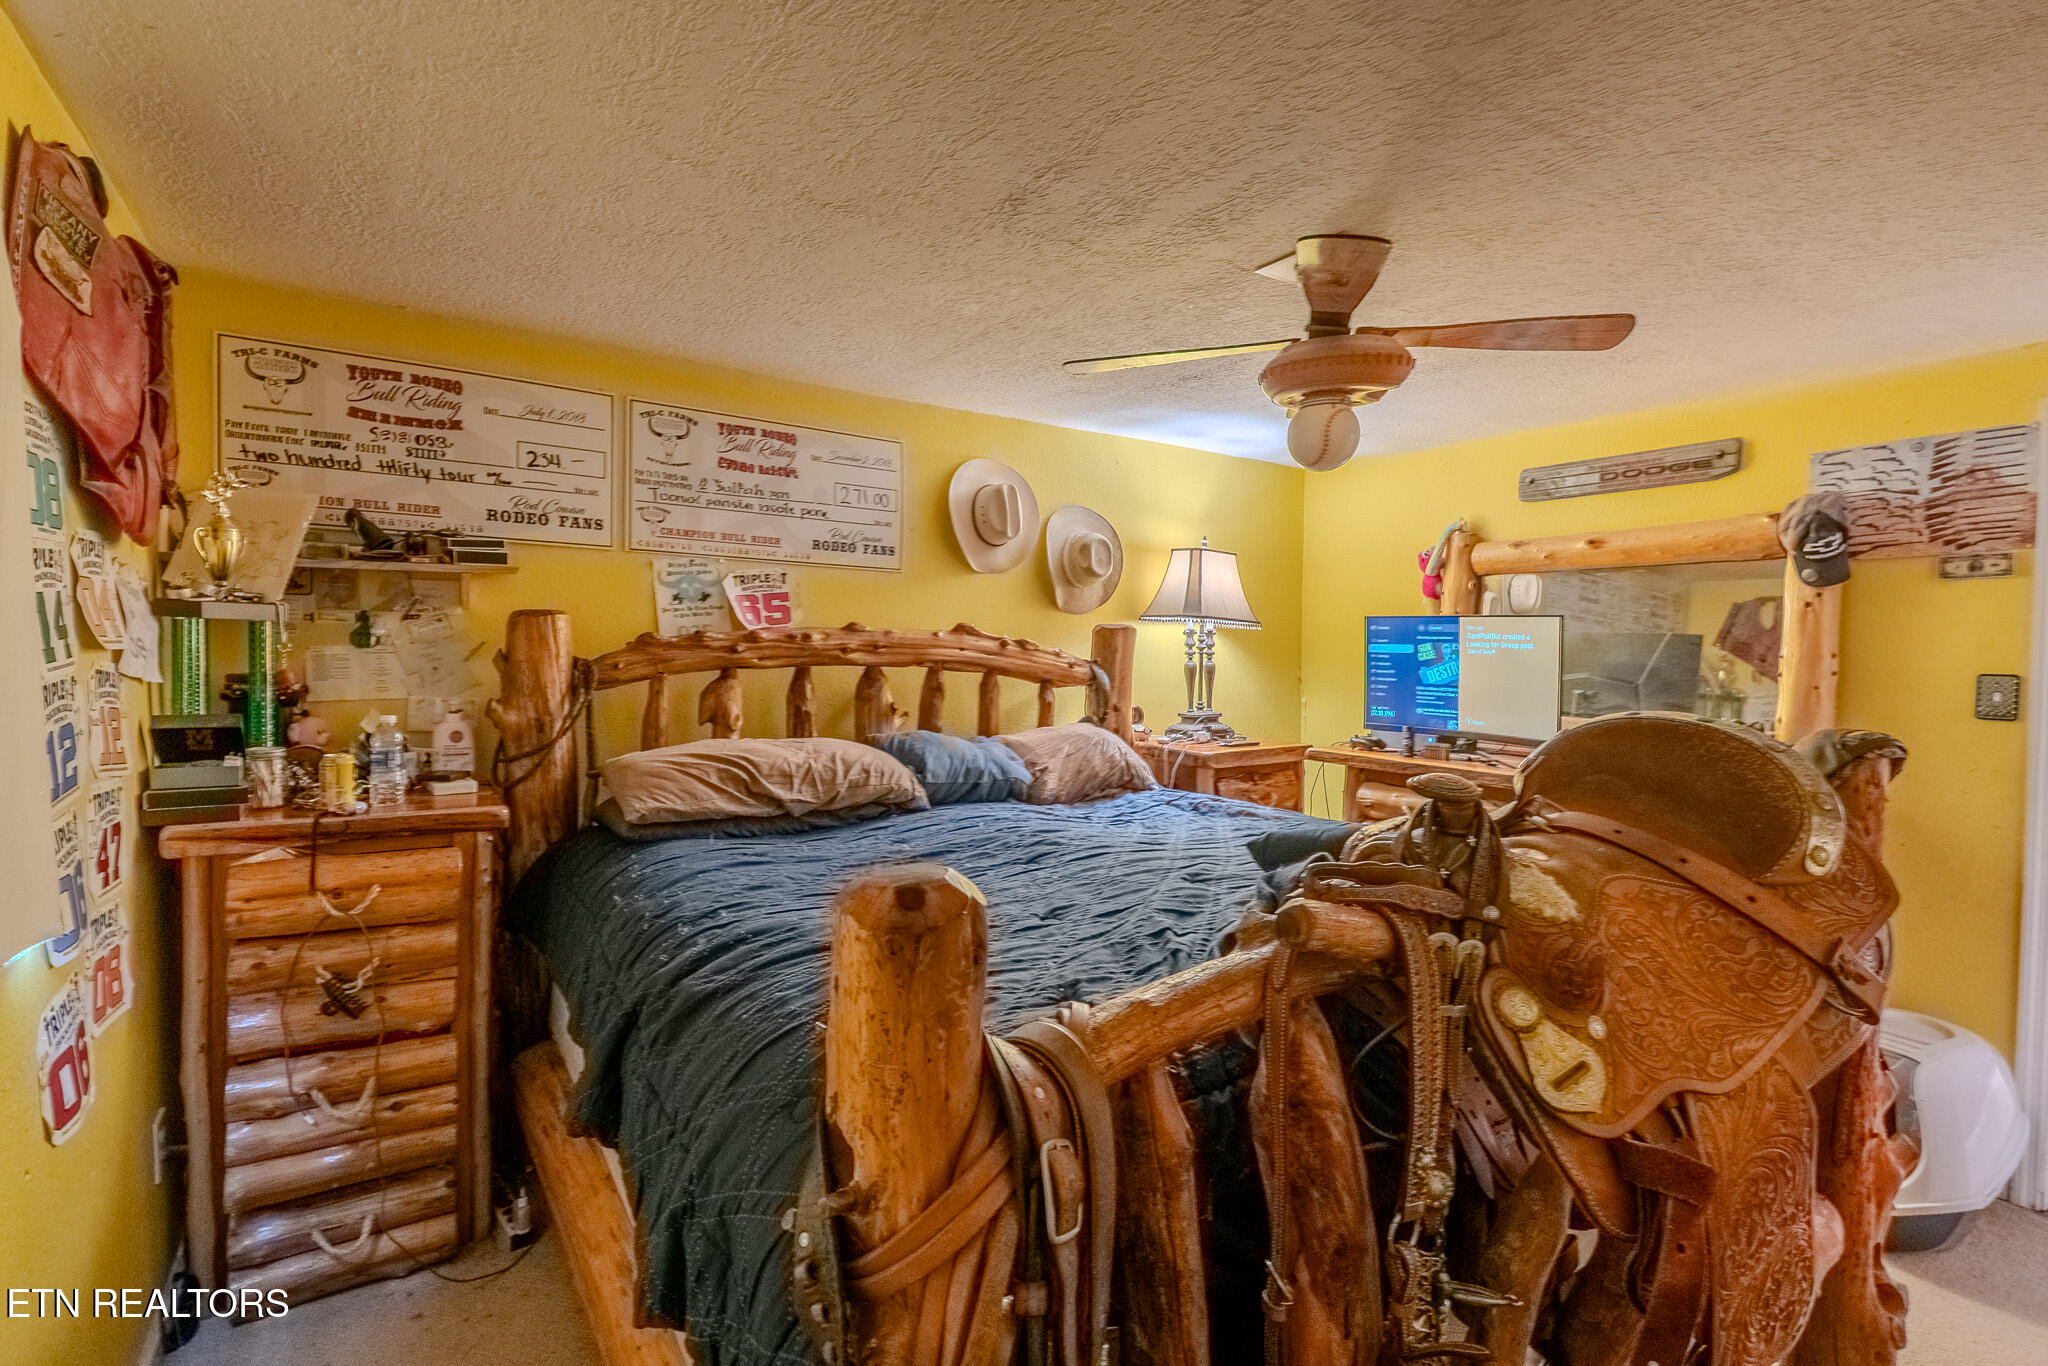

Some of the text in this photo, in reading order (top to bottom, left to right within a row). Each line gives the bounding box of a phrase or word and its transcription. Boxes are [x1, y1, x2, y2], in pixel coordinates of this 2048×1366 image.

[274, 349, 319, 368] FARMS
[346, 364, 464, 396] YOUTH RODEO
[345, 379, 402, 402] Bull
[402, 386, 462, 421] Riding
[526, 451, 560, 468] 234
[716, 434, 797, 466] Bull Riding
[238, 444, 280, 462] two
[284, 449, 362, 472] hundred
[376, 458, 432, 485] thirty
[1600, 459, 1713, 481] DODGE
[352, 498, 390, 510] BULL
[396, 502, 441, 515] RIDER
[486, 509, 604, 530] RODEO FANS
[659, 527, 781, 545] CHAMPION BULL RIDER
[812, 539, 857, 553] RODEO
[863, 544, 896, 556] FANS
[735, 592, 791, 626] 65
[36, 591, 72, 664] 14
[1502, 633, 1525, 641] created
[1466, 641, 1490, 650] Looking
[1500, 642, 1519, 650] Group
[1427, 661, 1459, 683] DESTR
[46, 722, 78, 803] 12
[96, 821, 121, 890] 47
[49, 1020, 91, 1131] 06
